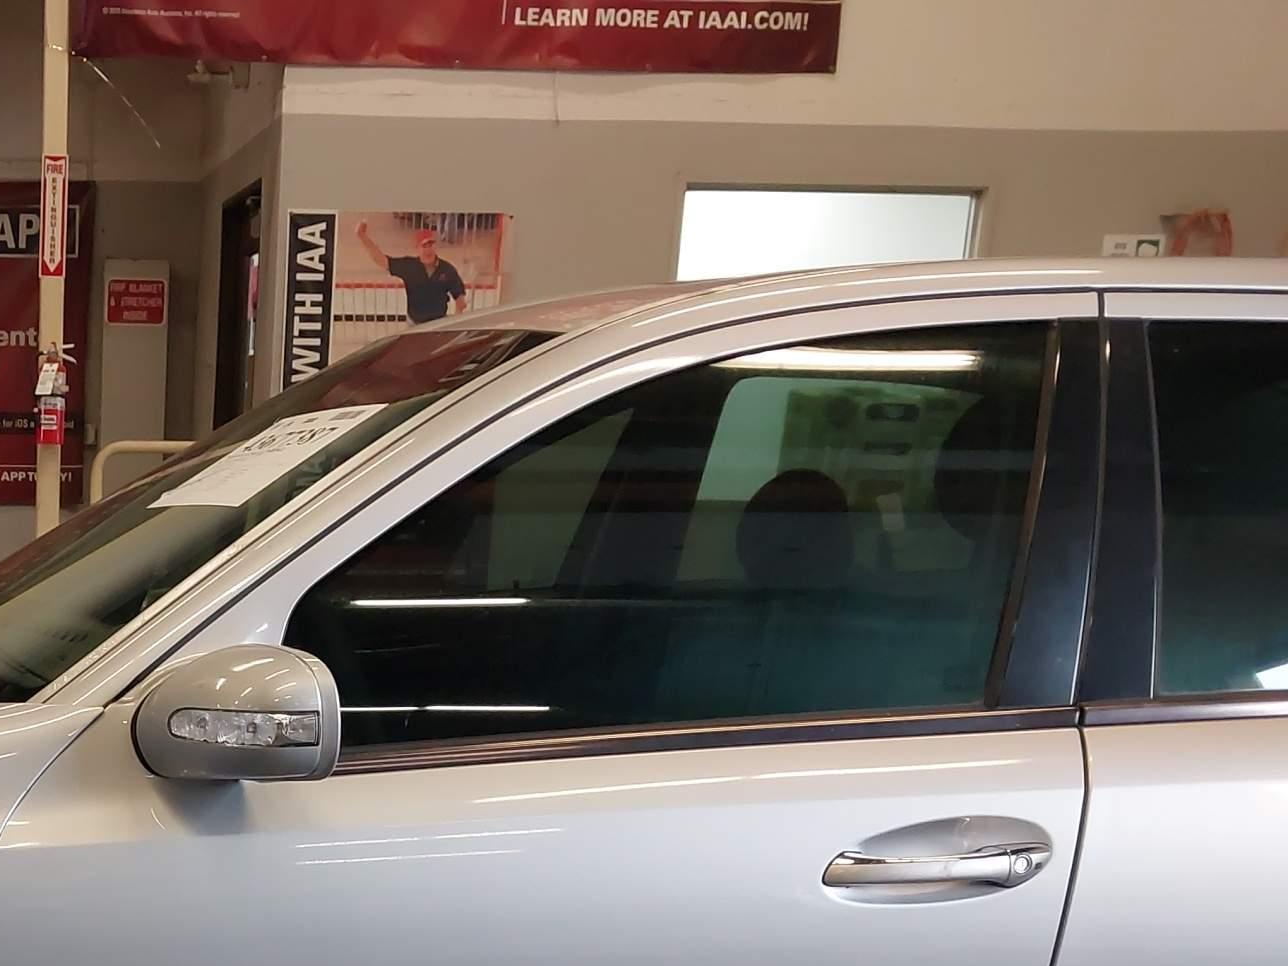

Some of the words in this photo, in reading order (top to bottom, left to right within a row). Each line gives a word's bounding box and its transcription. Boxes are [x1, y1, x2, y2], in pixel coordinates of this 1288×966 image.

[514, 7, 586, 29] LEARN
[594, 9, 659, 29] MORE
[663, 11, 693, 29] AT
[697, 11, 809, 31] IAAI.COM!
[47, 164, 64, 174] FIRE
[49, 177, 57, 264] EXTINGUISHER
[296, 222, 327, 281] IAA
[291, 293, 324, 382] WITH
[3, 419, 13, 428] for
[14, 419, 29, 428] iOS
[1, 471, 27, 482] APP
